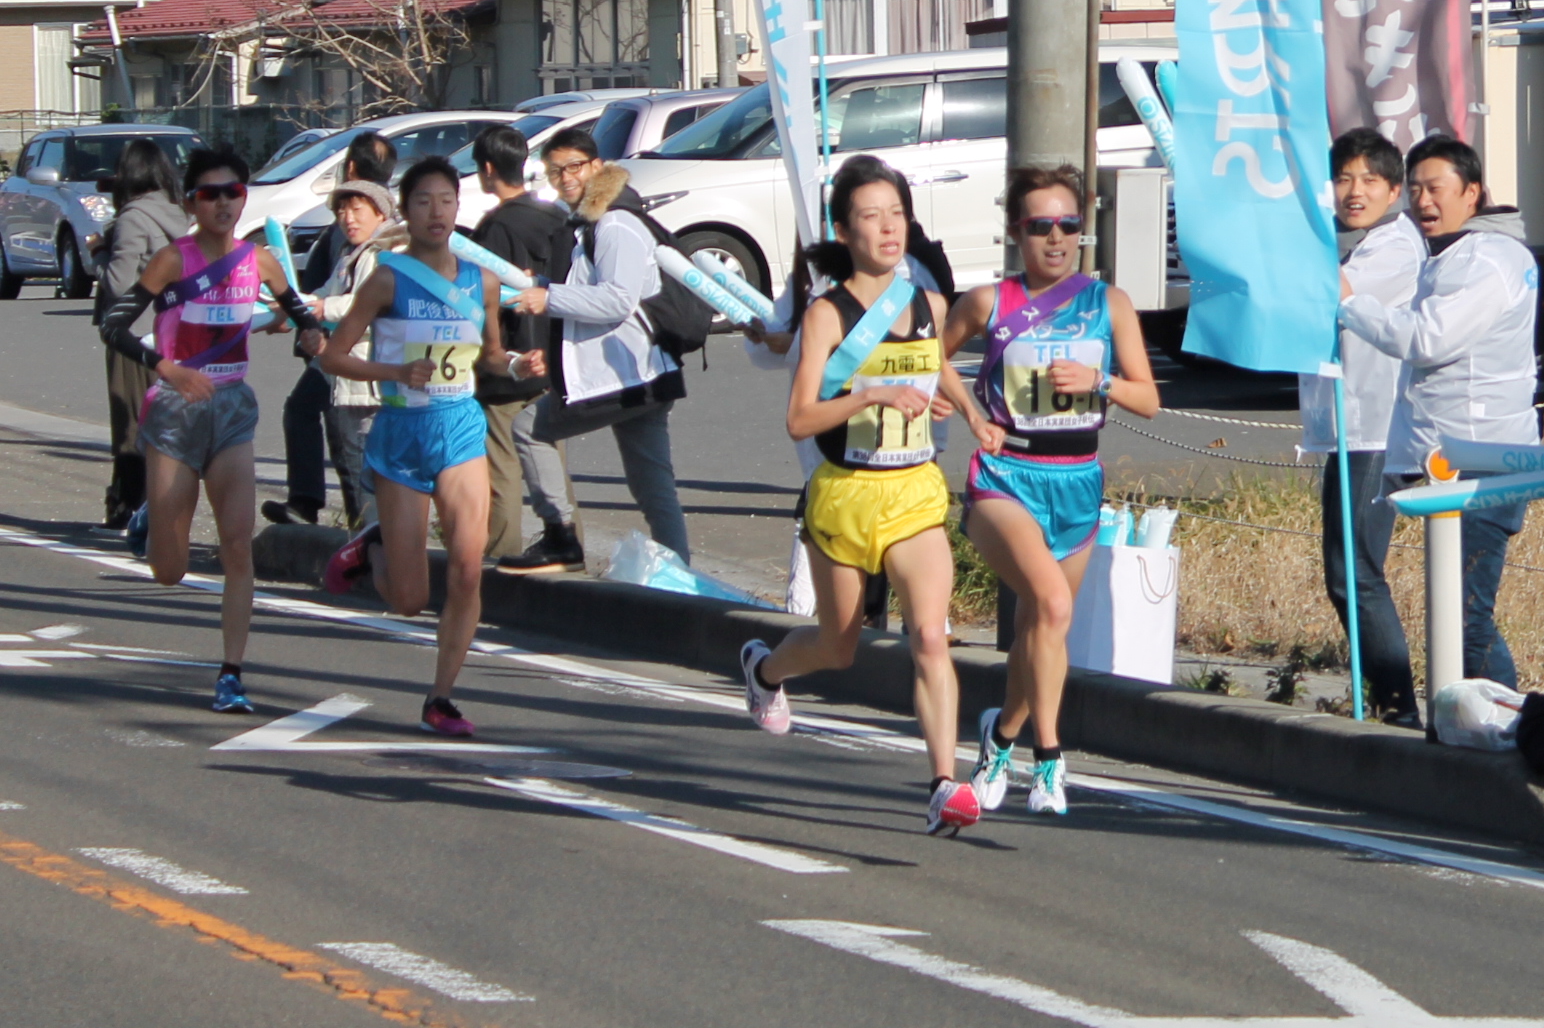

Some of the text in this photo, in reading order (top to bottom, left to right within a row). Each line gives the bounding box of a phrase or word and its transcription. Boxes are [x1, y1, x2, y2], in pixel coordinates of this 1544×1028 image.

[206, 306, 235, 322] TEL
[432, 326, 461, 341] TEL
[880, 354, 934, 374] 九電工
